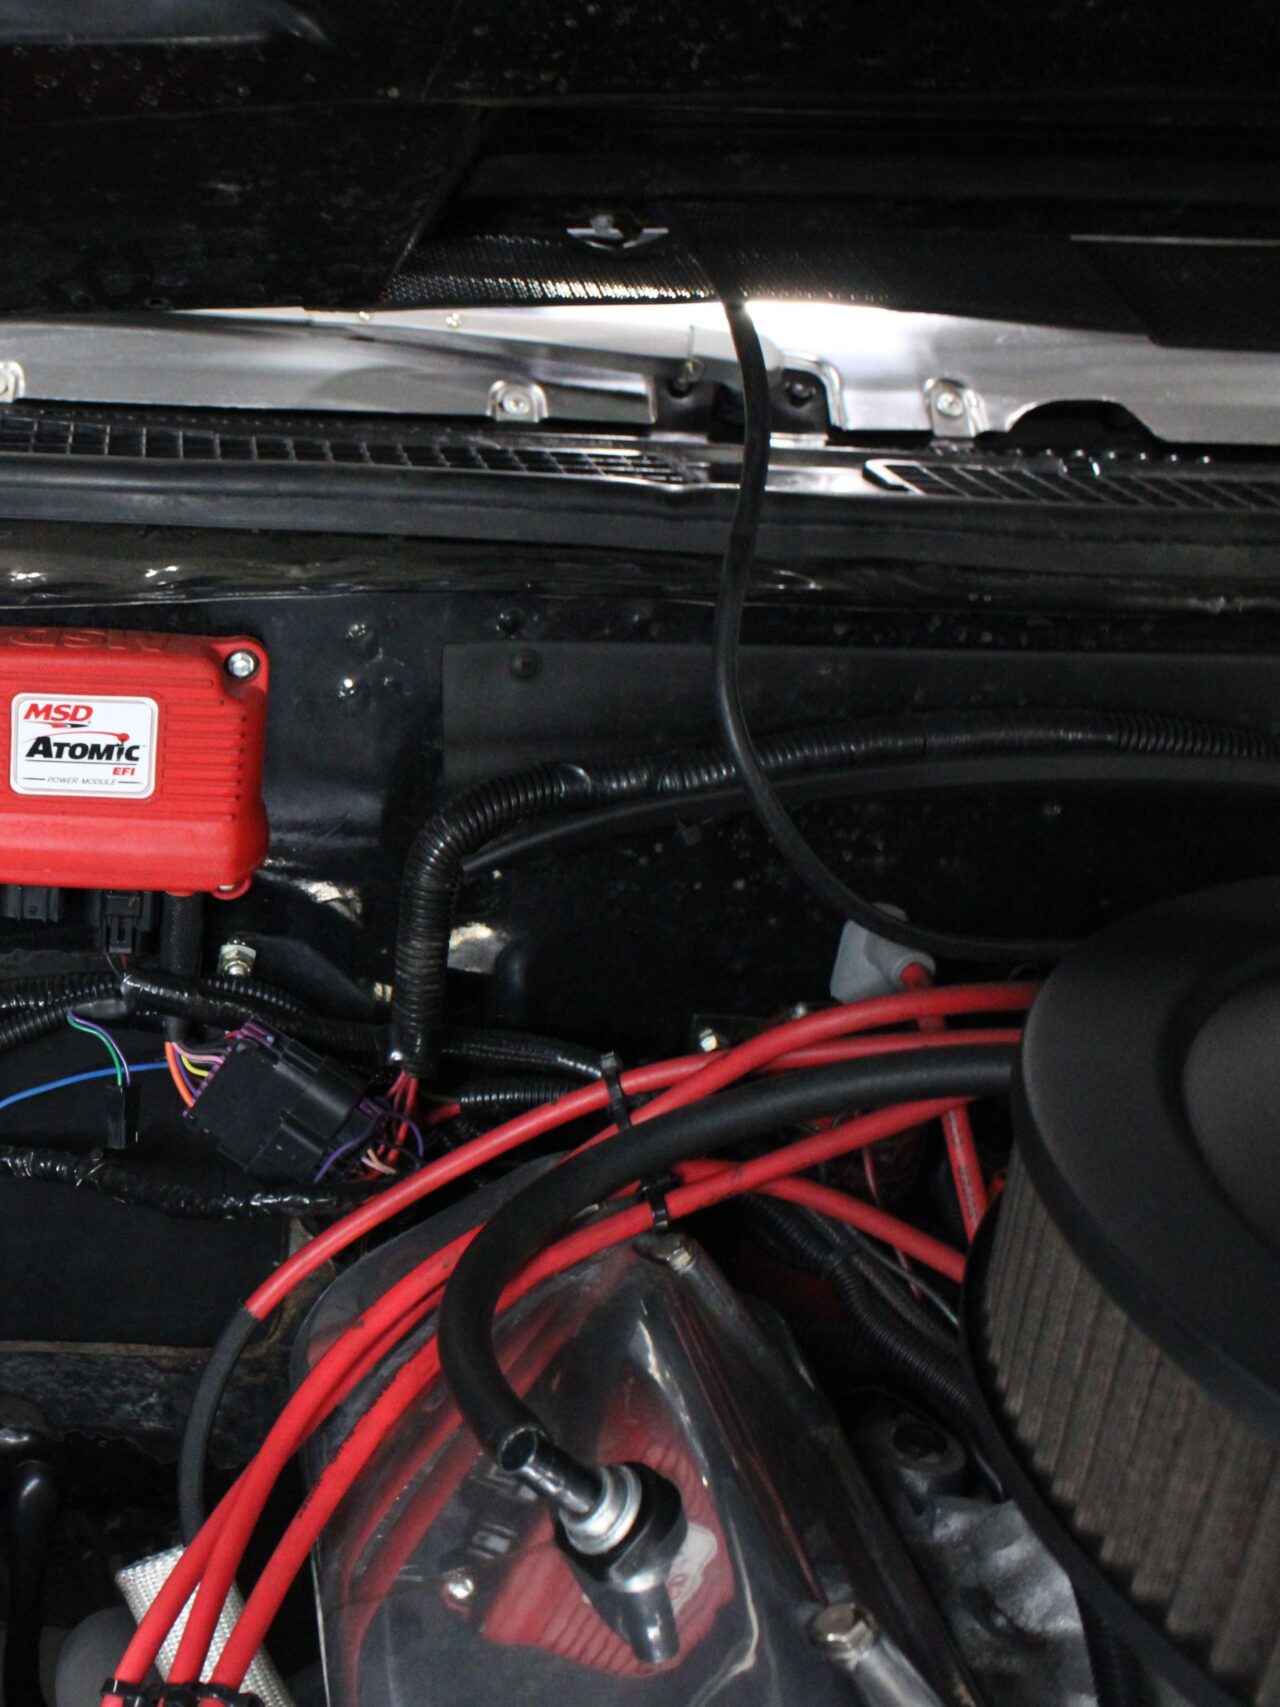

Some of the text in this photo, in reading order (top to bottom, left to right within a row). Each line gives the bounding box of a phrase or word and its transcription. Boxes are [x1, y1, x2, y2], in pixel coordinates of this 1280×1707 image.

[23, 703, 94, 722] MSD
[112, 767, 136, 776] EFI
[47, 777, 117, 786] POWER MODULE
